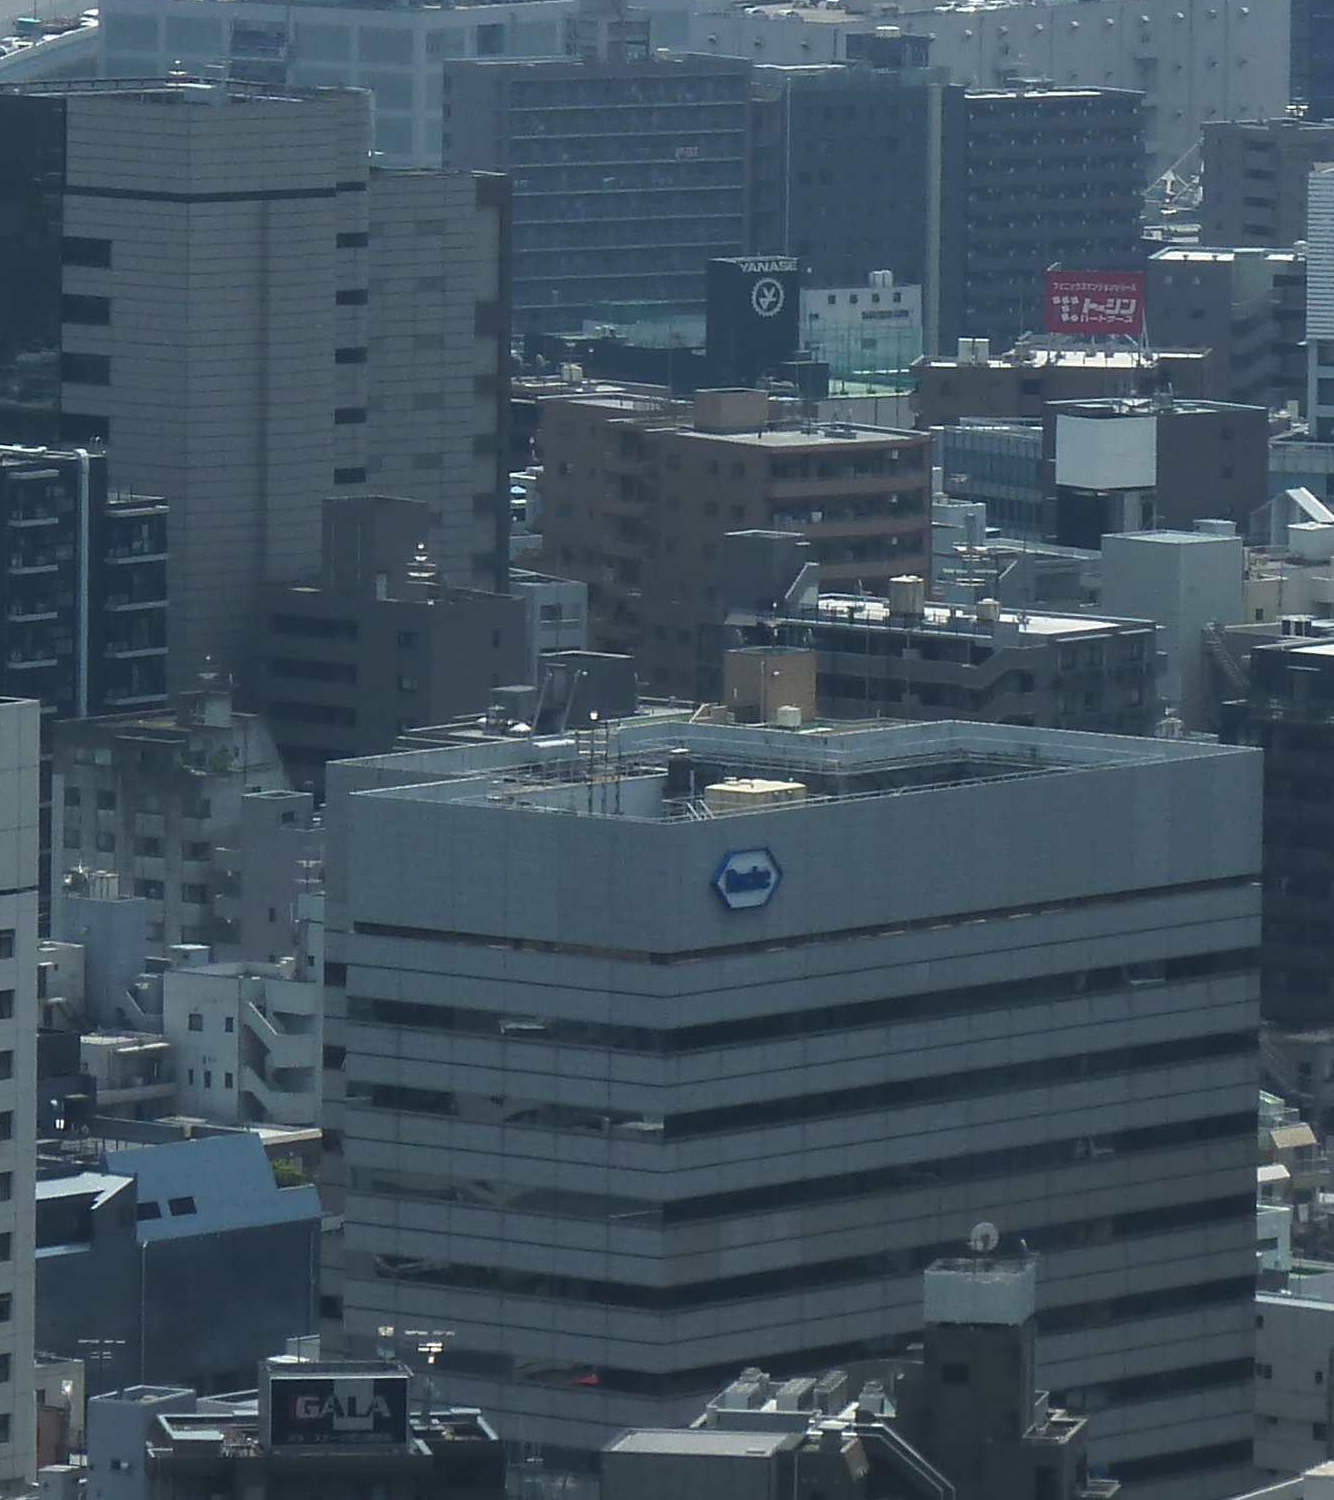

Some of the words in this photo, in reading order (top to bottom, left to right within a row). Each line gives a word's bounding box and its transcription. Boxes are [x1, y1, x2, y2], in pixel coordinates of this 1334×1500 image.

[740, 260, 798, 273] YANASE
[1082, 298, 1136, 315] トーシン
[295, 1396, 391, 1419] GALA
